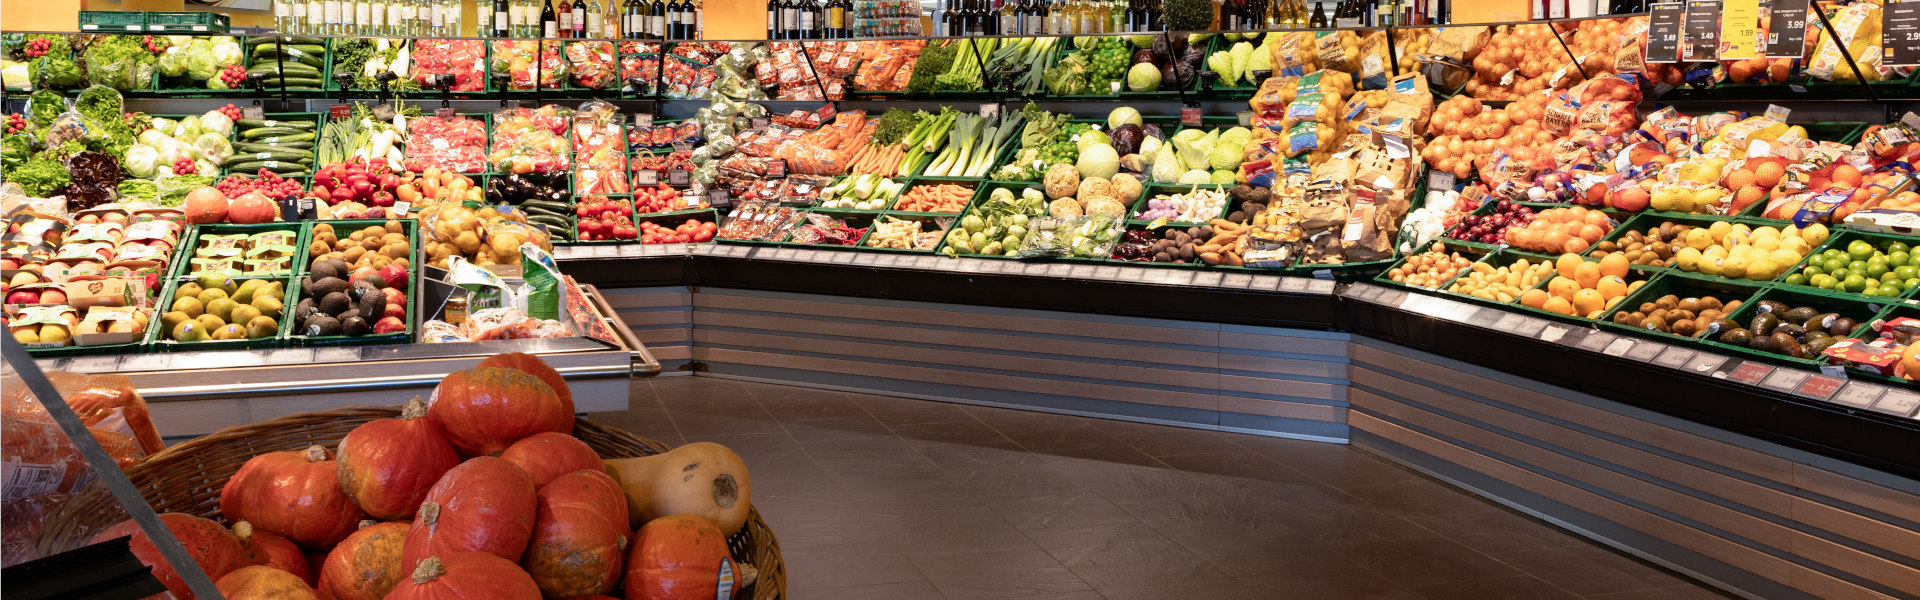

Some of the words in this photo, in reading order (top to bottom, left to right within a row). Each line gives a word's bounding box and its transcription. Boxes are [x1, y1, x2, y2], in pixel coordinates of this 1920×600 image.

[1787, 20, 1804, 29] 3.99
[1701, 32, 1714, 40] 3.49
[1740, 29, 1754, 37] 1.99
[1663, 34, 1676, 42] 3.49
